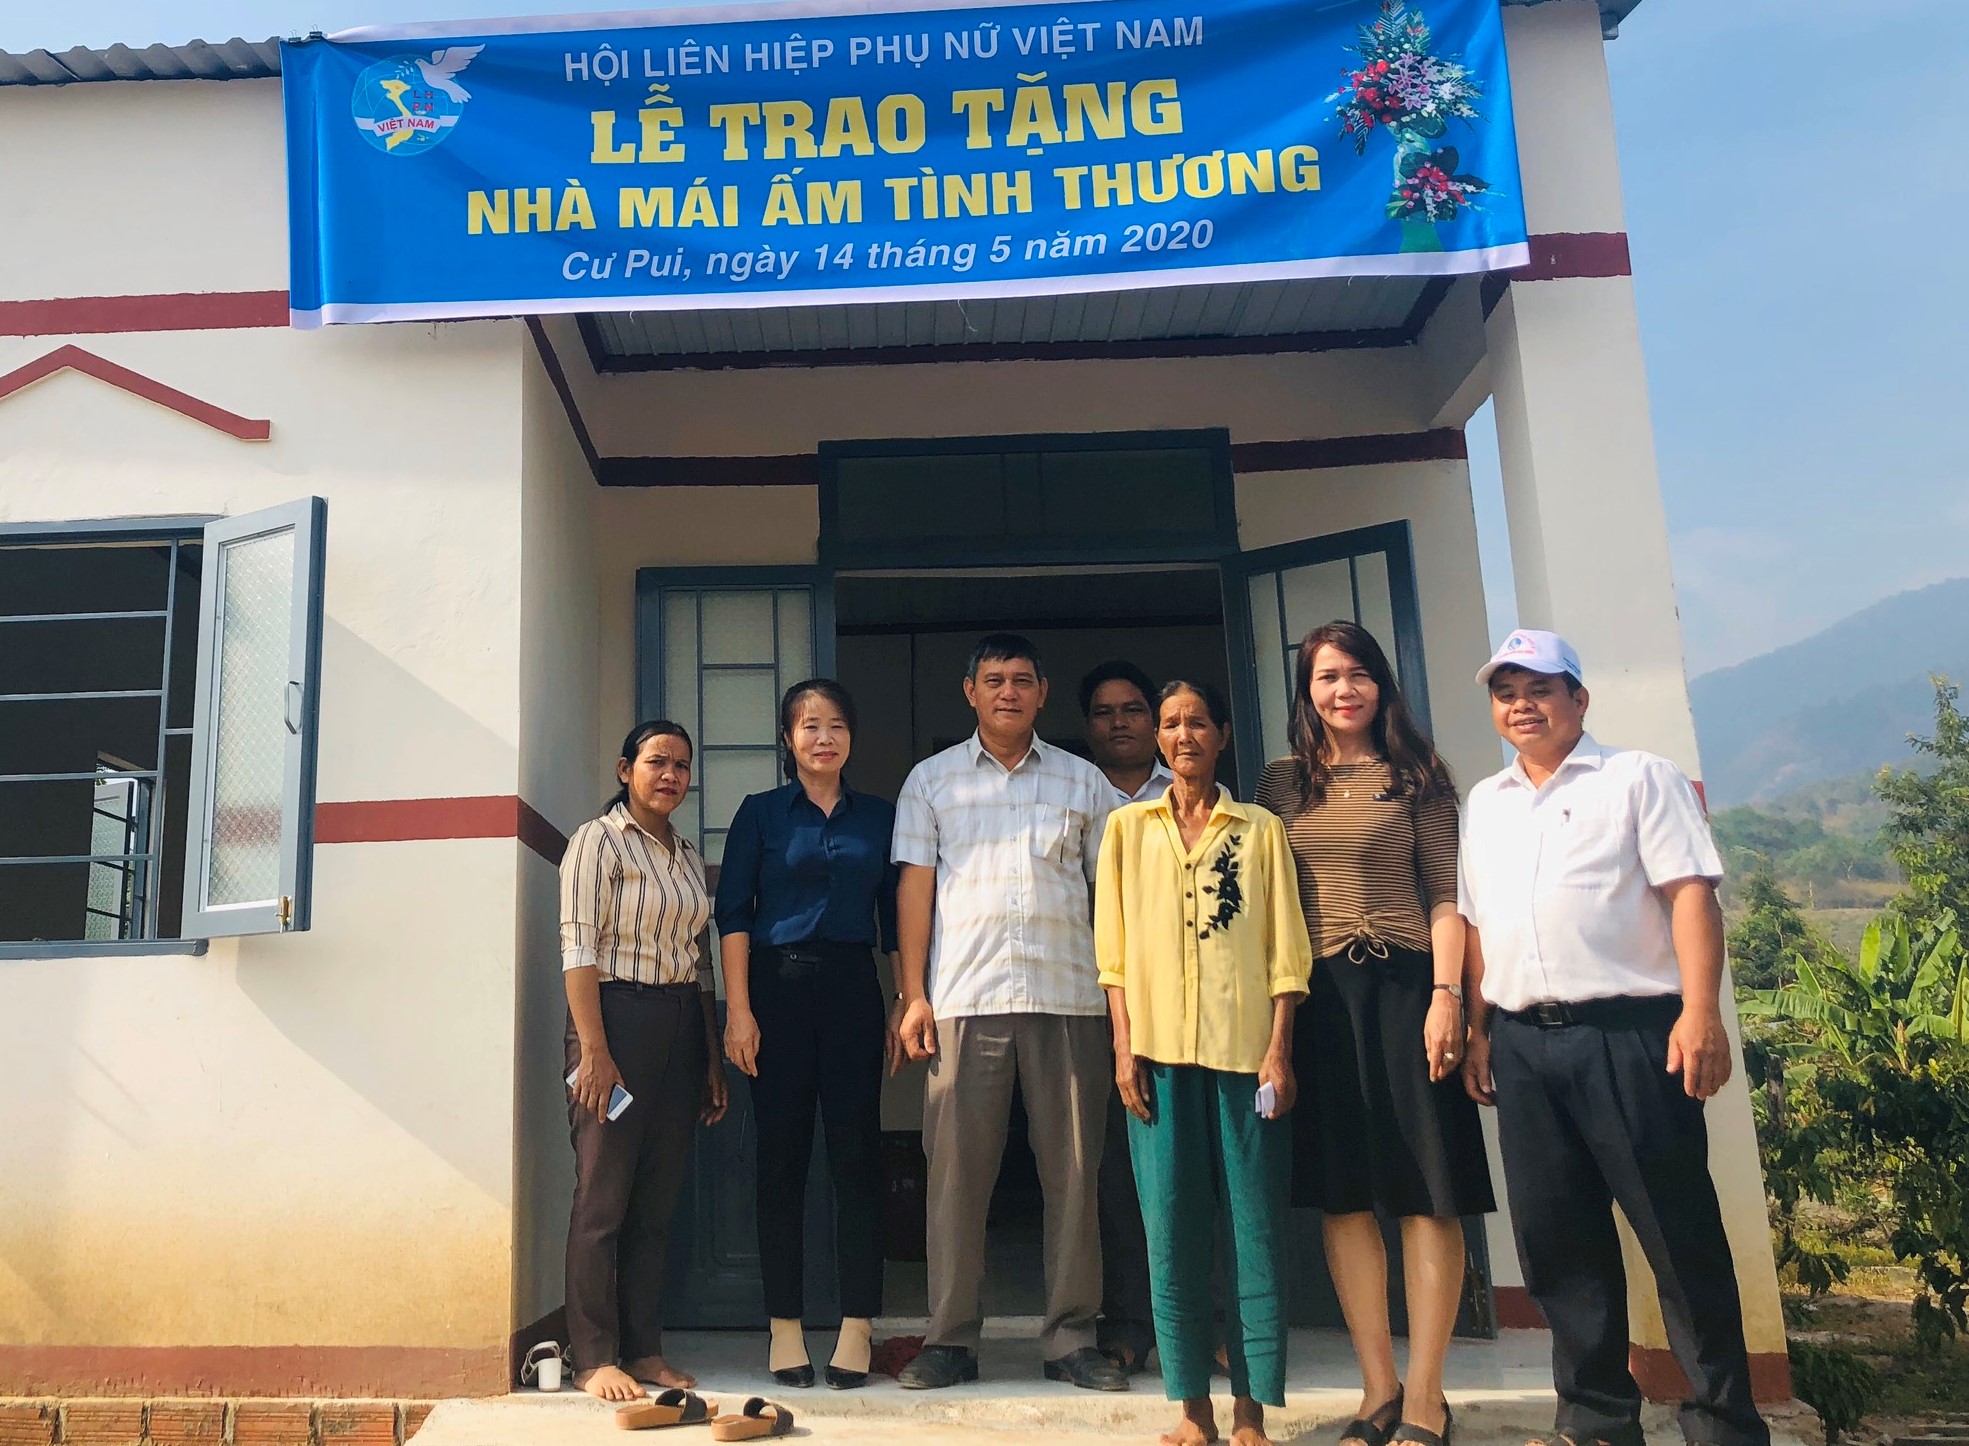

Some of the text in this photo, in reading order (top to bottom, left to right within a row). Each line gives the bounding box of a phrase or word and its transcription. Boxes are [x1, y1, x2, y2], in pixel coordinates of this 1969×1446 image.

[566, 17, 1202, 85] HỘI LIÊN HIỆP PHỤ NỮ VIỆT NAM
[377, 118, 435, 132] VIỆT NAM
[591, 72, 1184, 163] LỄ TRAO TẶNG
[468, 145, 1320, 234] NHÀ MÁI ẤM TÌNH THƯƠNG
[563, 220, 1213, 282] Cư Pui, ngày 14 tháng 5 năm 2020
